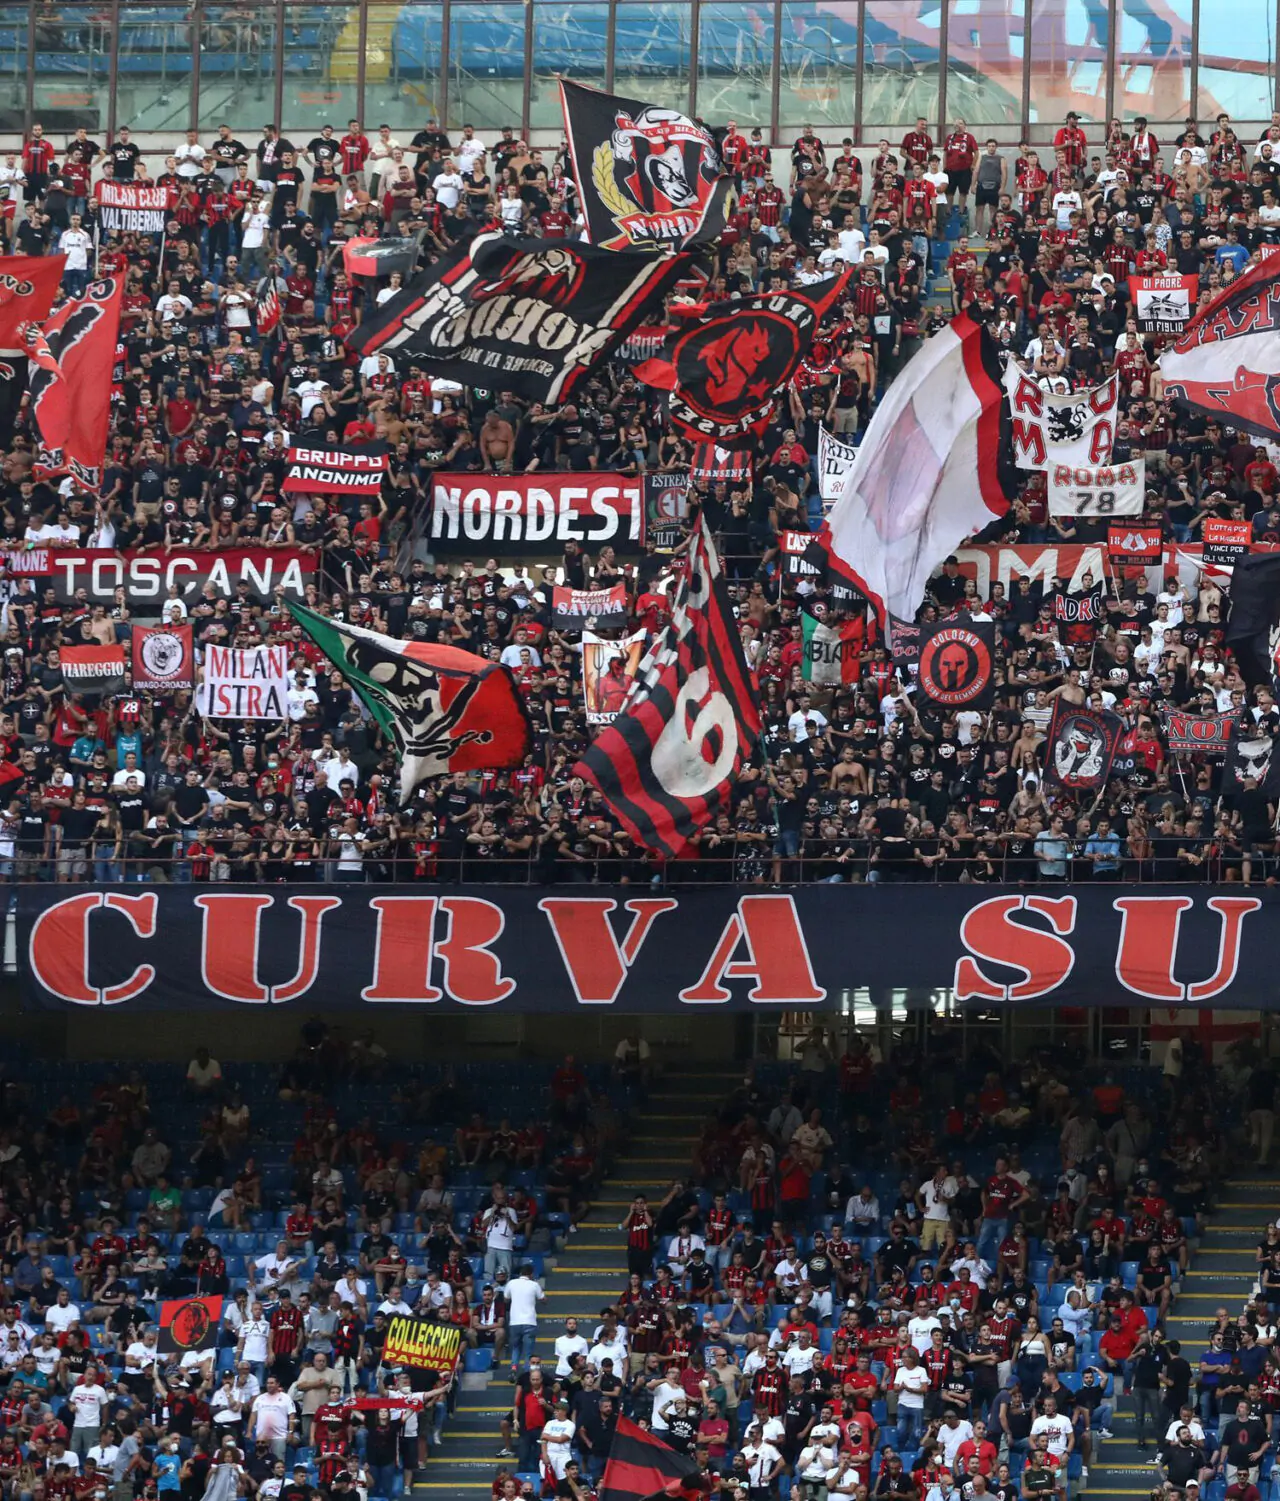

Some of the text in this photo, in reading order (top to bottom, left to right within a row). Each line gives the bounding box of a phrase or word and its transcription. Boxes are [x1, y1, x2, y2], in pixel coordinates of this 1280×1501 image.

[102, 183, 167, 207] MILAN CLUB
[1143, 277, 1182, 288] DI PADRE
[1145, 321, 1184, 332] IN FIGLIO
[296, 449, 383, 467] GRUPPO
[288, 466, 383, 486] ANONIMO
[651, 474, 691, 488] ESTREM
[1053, 464, 1139, 487] ROMA
[1109, 535, 1160, 546] 18 99
[1217, 555, 1236, 563] ULTR
[55, 557, 305, 596] TOSCANA
[557, 600, 624, 616] SAVONA
[931, 629, 980, 647] COLOGNO
[61, 661, 125, 678] VIAREGGIO
[210, 647, 284, 679] MILAN
[133, 680, 192, 689] UMAGO-CROAZIA
[122, 700, 139, 713] 28
[209, 683, 284, 717] ISTRA
[1168, 716, 1235, 741] NOI
[29, 892, 827, 1005] CURVA
[387, 1317, 461, 1360] COLLECCHIO
[384, 1351, 452, 1370] PARMA
